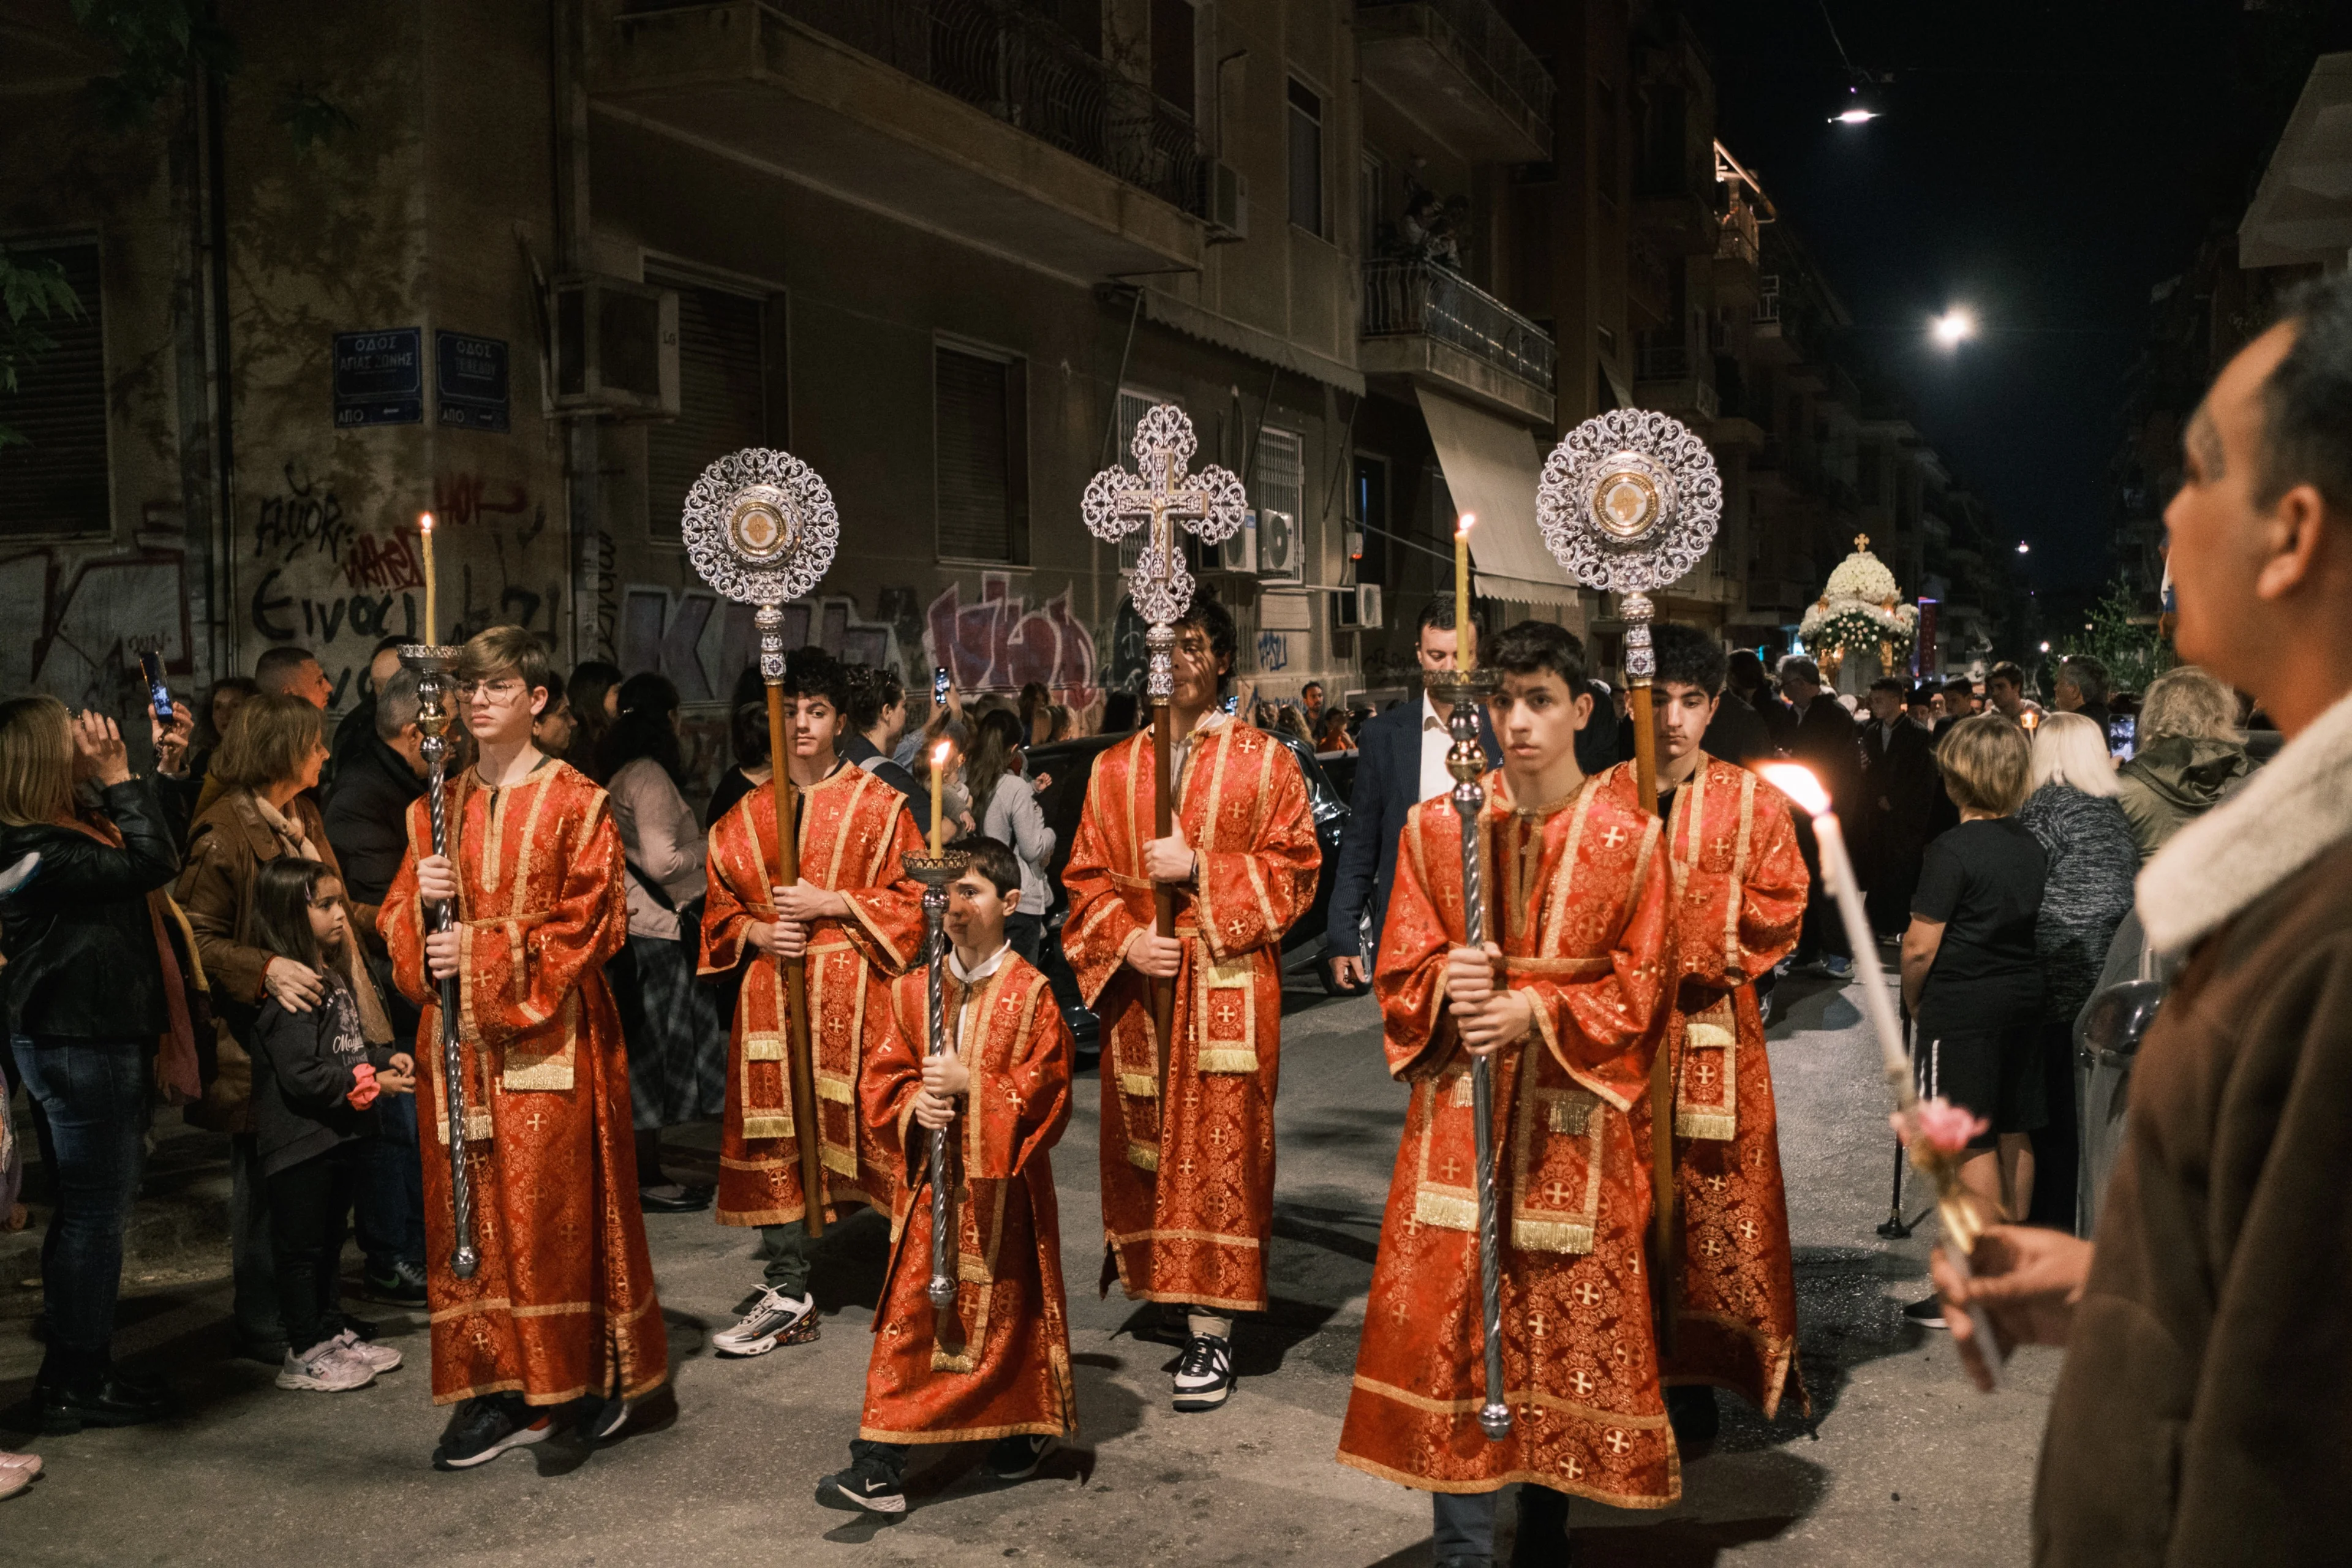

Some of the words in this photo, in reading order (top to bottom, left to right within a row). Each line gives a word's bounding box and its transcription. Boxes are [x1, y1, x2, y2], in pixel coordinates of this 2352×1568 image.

[355, 336, 398, 352] ΟΔΟΣ
[456, 341, 492, 358] ΟΔΟΣ
[339, 355, 372, 372] ΑΓΙΑΣ
[375, 351, 413, 369] ΖΩΝΗΣ
[337, 408, 365, 424] ΑΠΟ
[442, 408, 466, 423] ΑΠΟ
